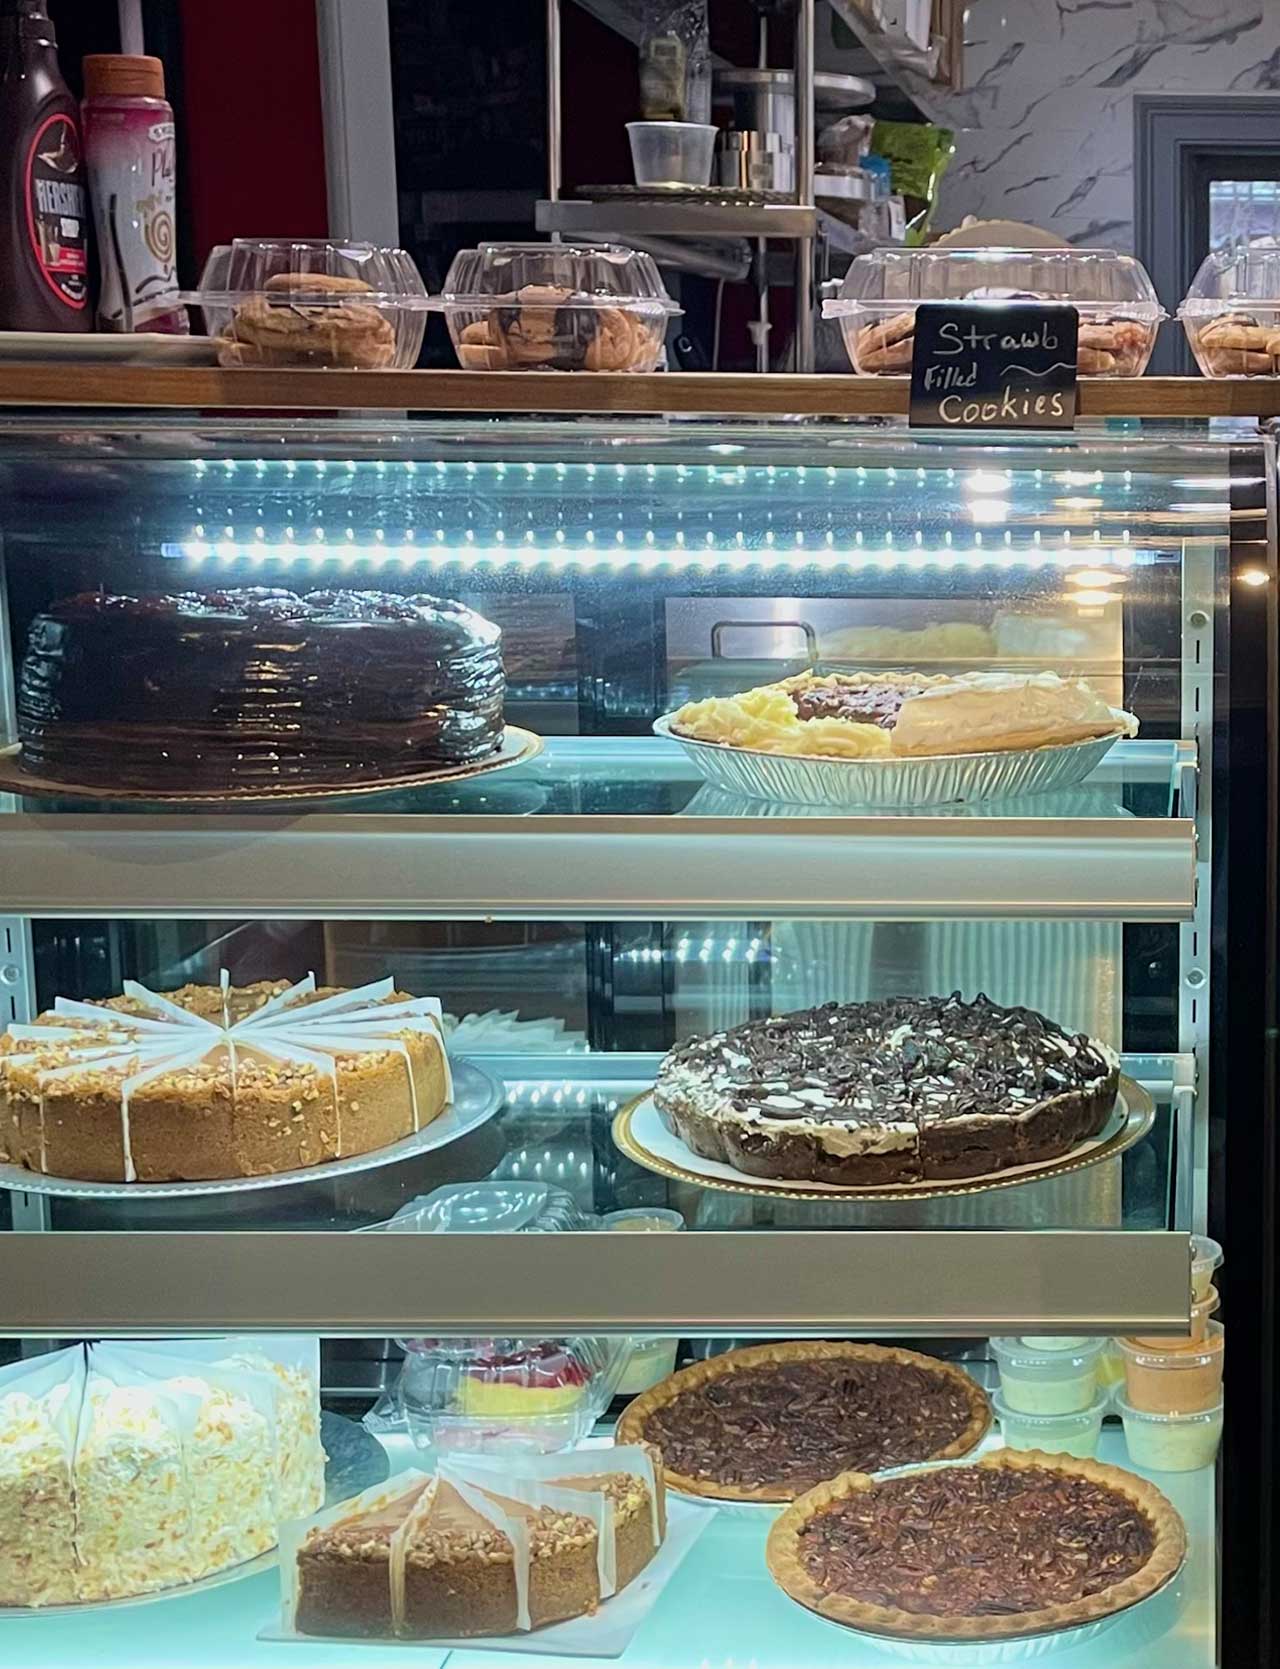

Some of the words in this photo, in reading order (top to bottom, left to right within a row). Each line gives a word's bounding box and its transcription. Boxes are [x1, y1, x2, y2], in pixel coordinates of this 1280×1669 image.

[932, 322, 1059, 355] Strawb
[924, 362, 978, 391] Filled
[938, 386, 1064, 424] Cookies
